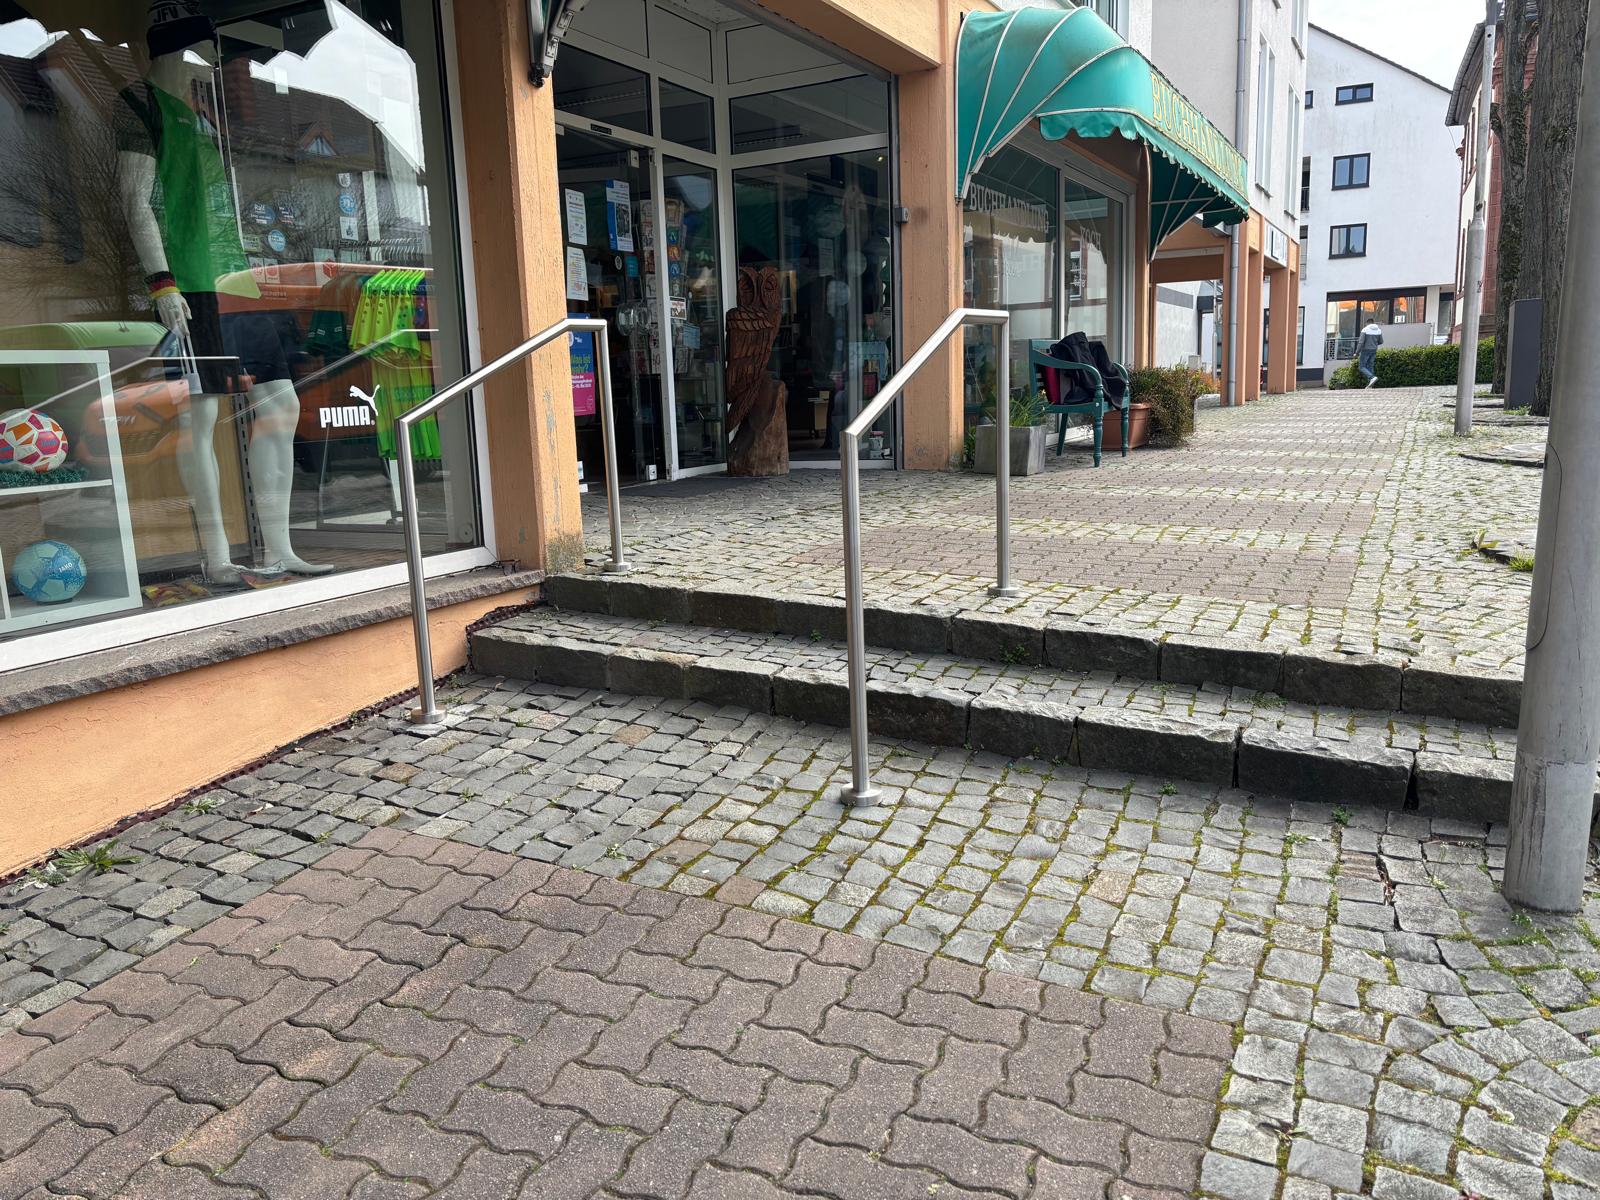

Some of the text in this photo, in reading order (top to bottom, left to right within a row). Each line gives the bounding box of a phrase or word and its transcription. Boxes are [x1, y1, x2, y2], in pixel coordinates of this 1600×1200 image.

[153, 5, 179, 24] JFV
[969, 182, 1050, 234] BUCHHANDLUNG
[1080, 226, 1102, 252] KOCH
[319, 405, 371, 429] PUMA
[58, 561, 74, 574] JAKO
